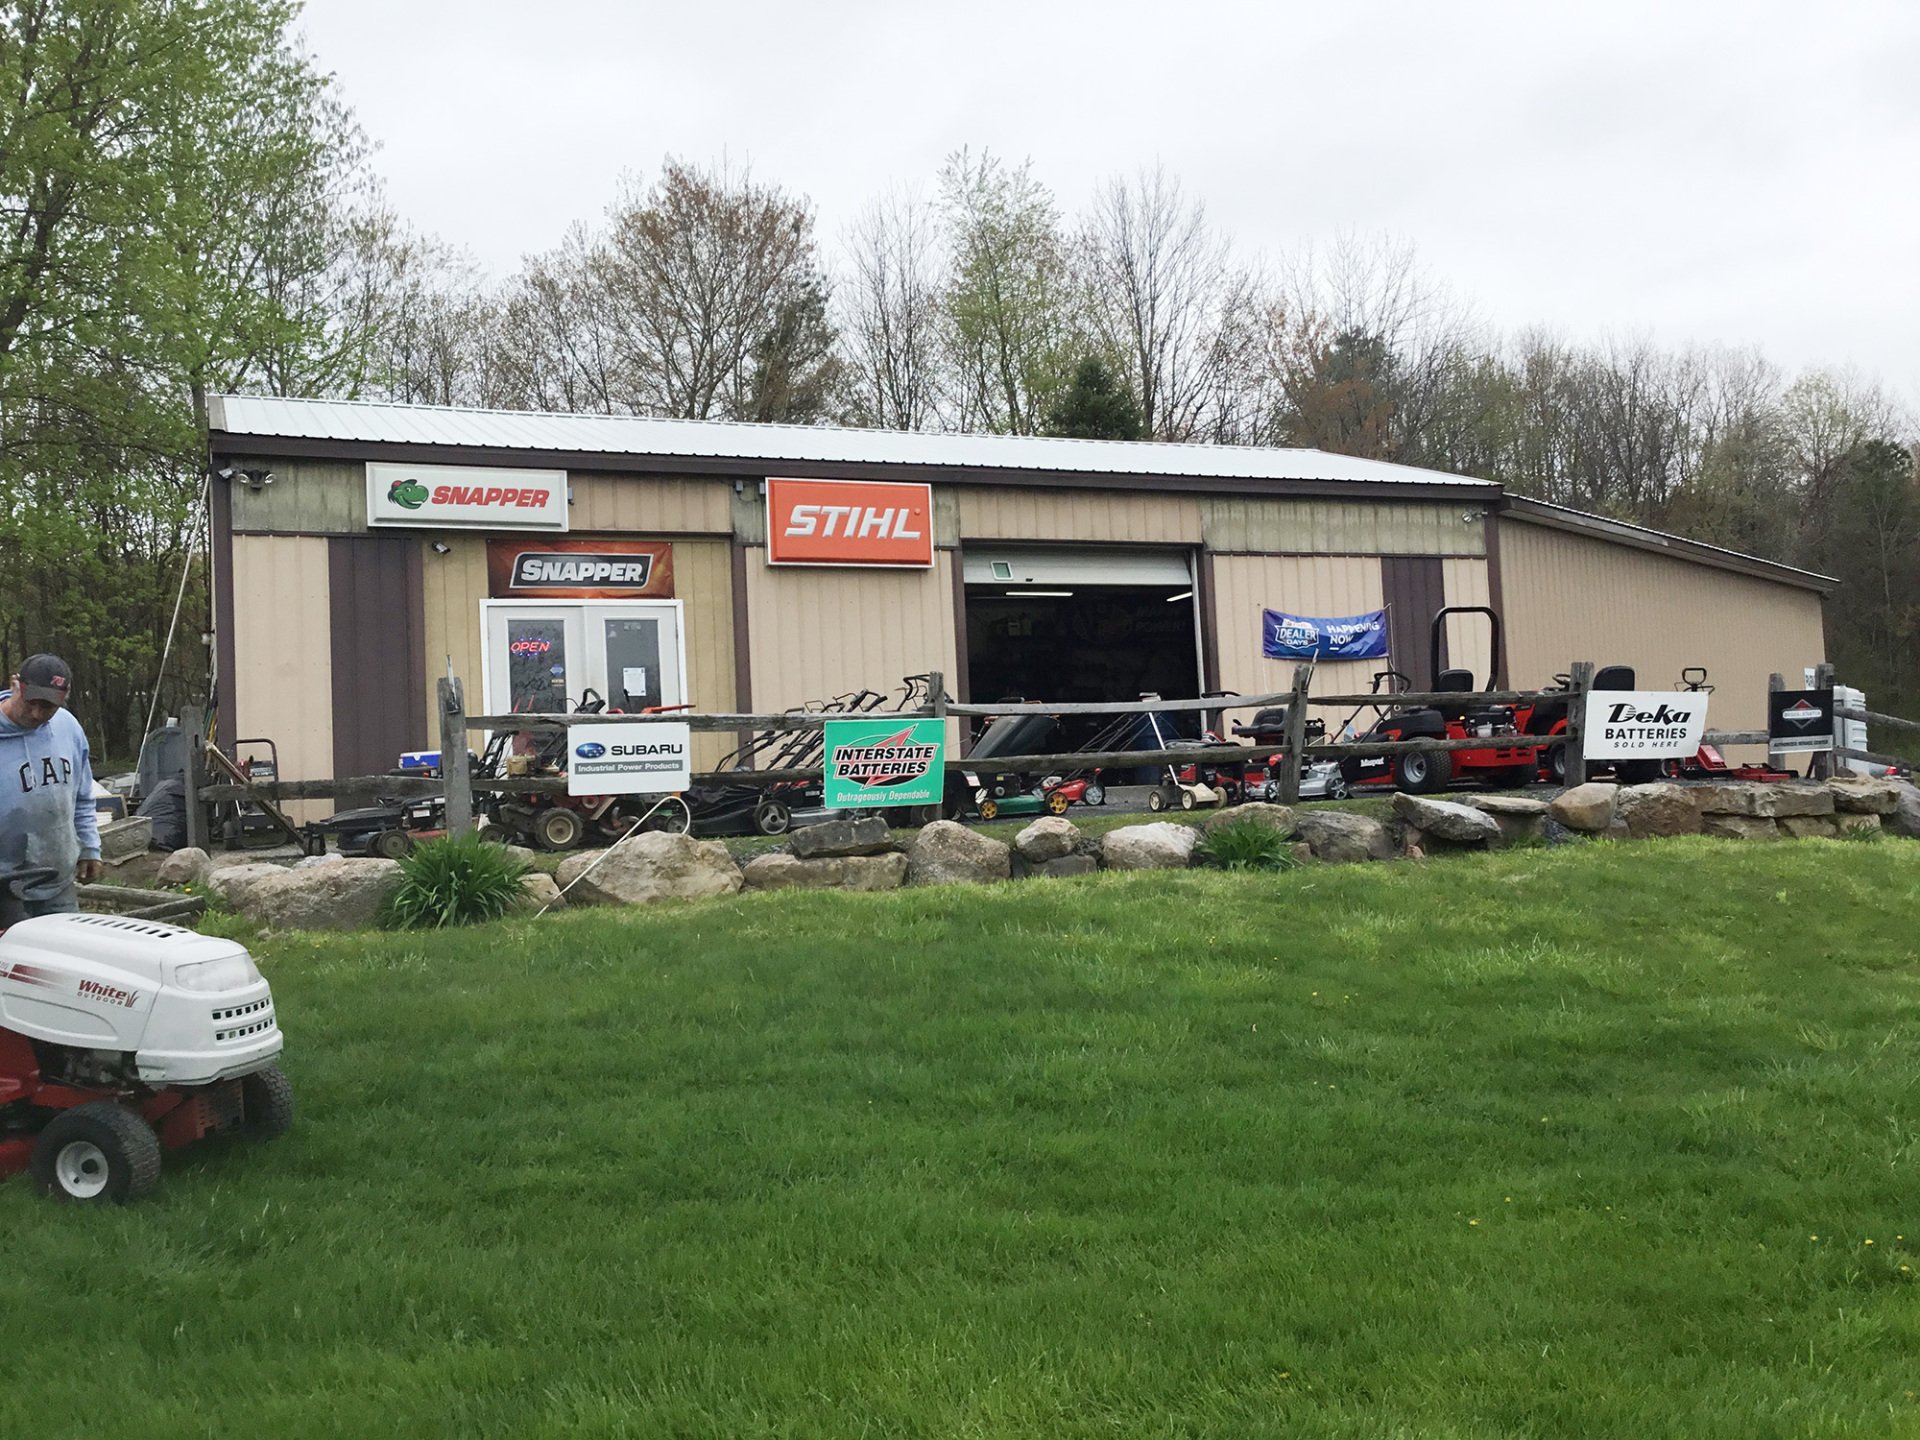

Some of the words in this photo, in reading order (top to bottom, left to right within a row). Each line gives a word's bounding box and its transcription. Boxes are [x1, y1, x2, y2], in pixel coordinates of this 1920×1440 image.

[431, 485, 550, 508] SNAPPER
[784, 504, 921, 540] STIHL
[520, 559, 643, 582] SNAPPER
[1279, 627, 1316, 641] DEALER
[1329, 634, 1354, 645] NOW
[510, 640, 550, 652] OPEN
[1286, 638, 1308, 646] DAYS
[1607, 703, 1691, 726] Deka
[1605, 727, 1688, 740] BATTERIES
[610, 743, 683, 756] SUBARU
[1613, 740, 1646, 749] SOLD
[1651, 740, 1680, 748] HERE
[835, 746, 935, 761] INTERSTATE
[578, 764, 615, 773] Industrial
[617, 763, 642, 772] Power
[644, 761, 680, 771] Products
[837, 761, 927, 776] BATTERIES
[836, 791, 887, 804] Outrageously
[889, 789, 931, 801] Dependable
[79, 979, 128, 1001] White
[77, 991, 123, 1006] OUTDOOR
